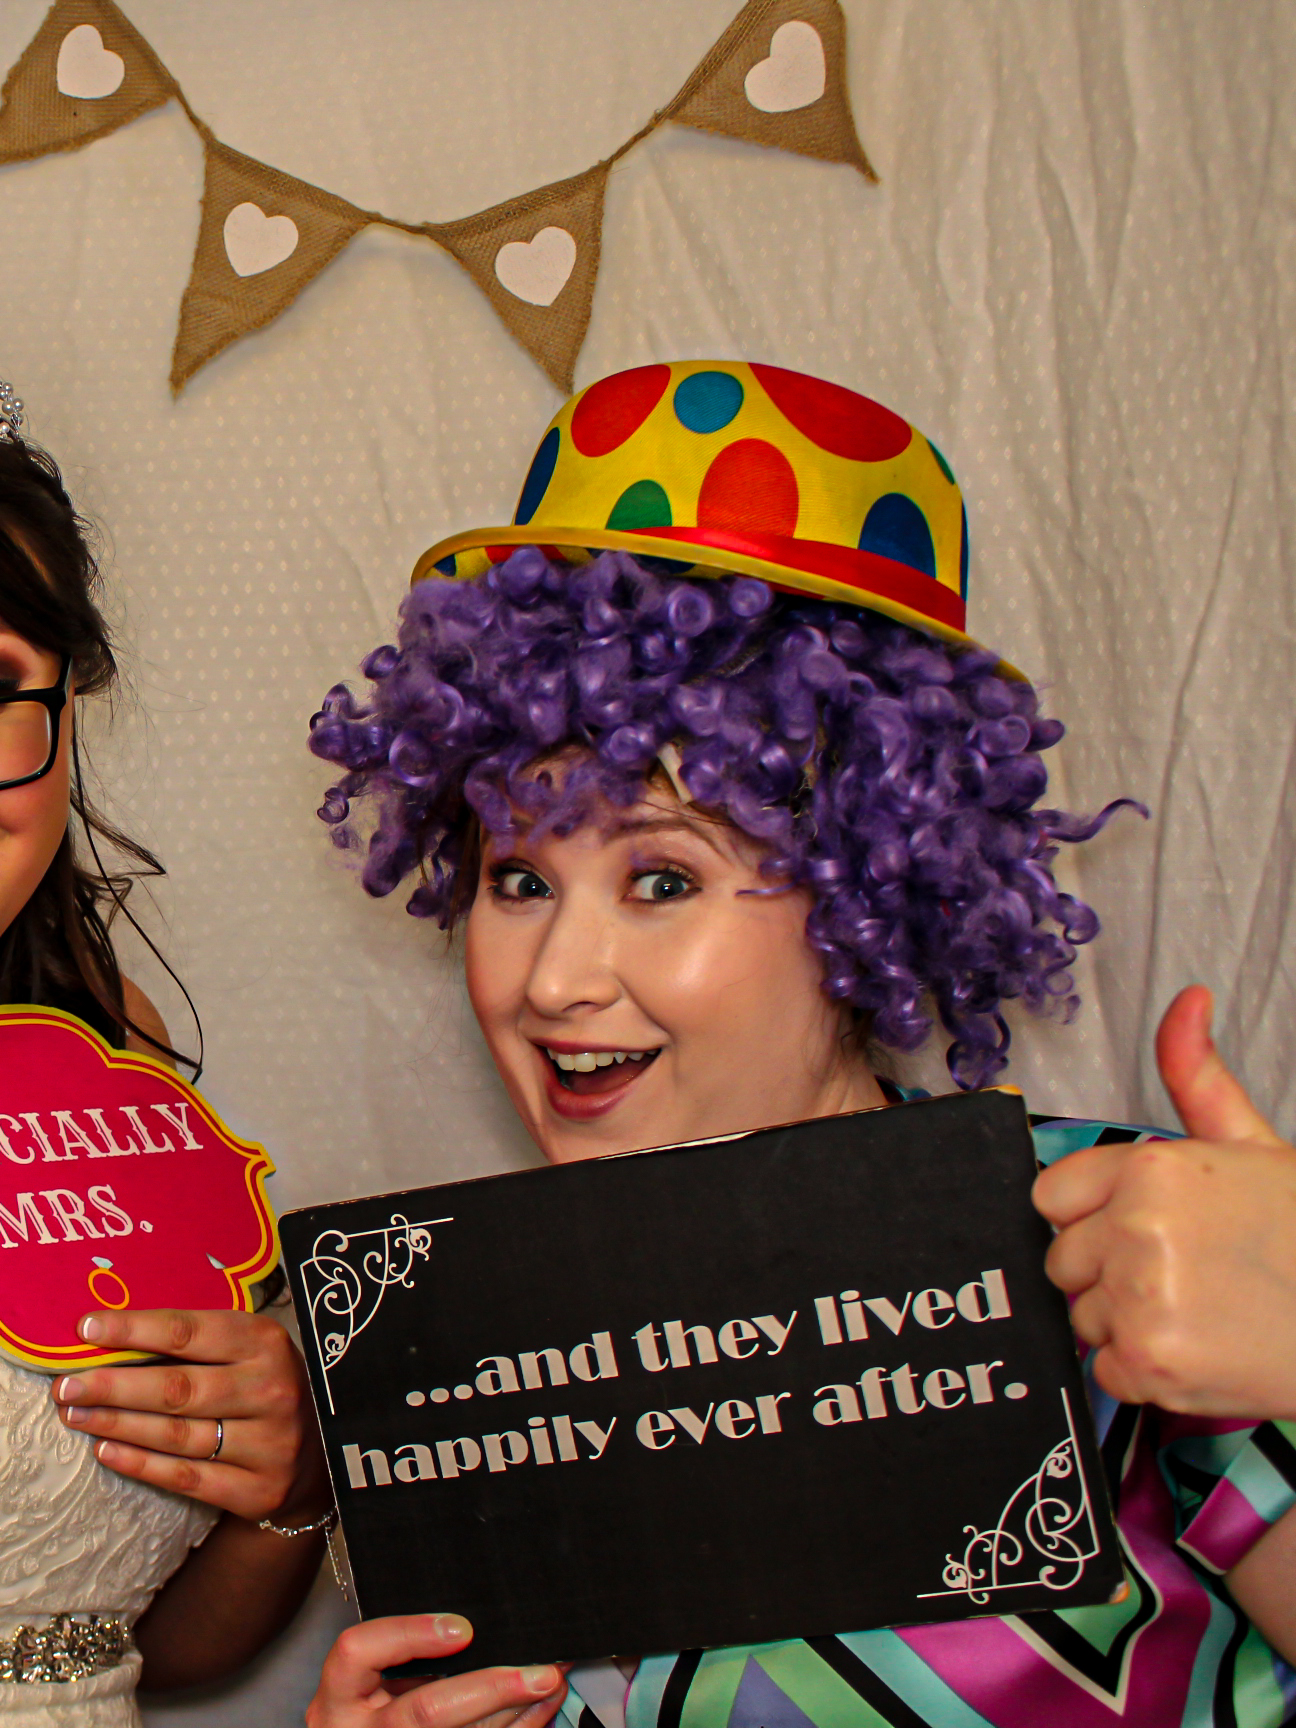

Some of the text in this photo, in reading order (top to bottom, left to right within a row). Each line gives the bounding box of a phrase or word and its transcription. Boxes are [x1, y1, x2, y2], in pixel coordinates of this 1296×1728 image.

[405, 1268, 1011, 1407] ...and they lived
[341, 1360, 1027, 1489] happily ever after.
